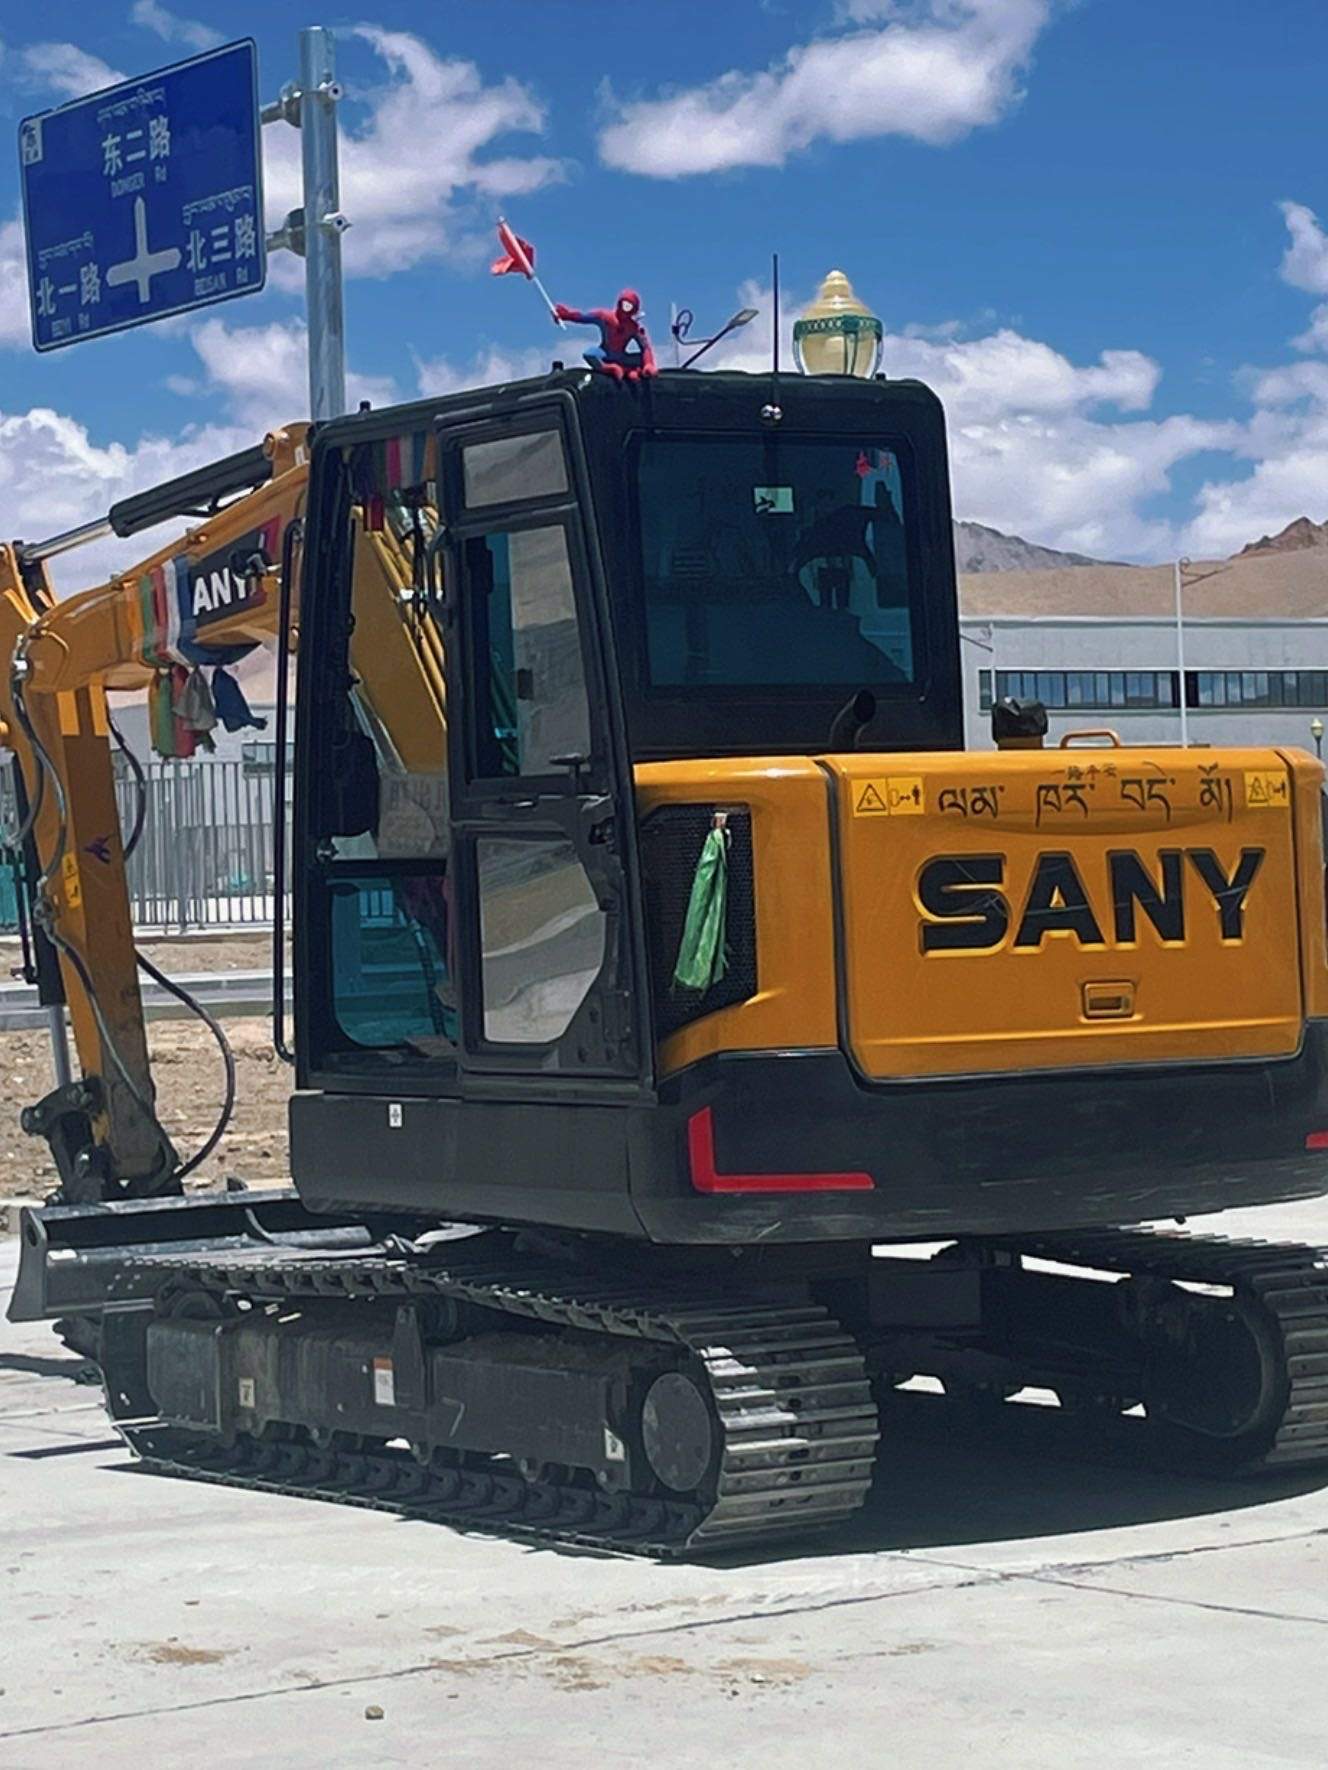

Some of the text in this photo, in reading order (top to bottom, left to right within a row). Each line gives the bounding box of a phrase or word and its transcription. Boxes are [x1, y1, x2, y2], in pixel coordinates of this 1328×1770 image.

[102, 114, 171, 176] 东二路
[186, 213, 257, 274] 北三路
[36, 261, 101, 317] 北一路
[193, 564, 247, 616] ANY
[912, 847, 1267, 957] SANY
